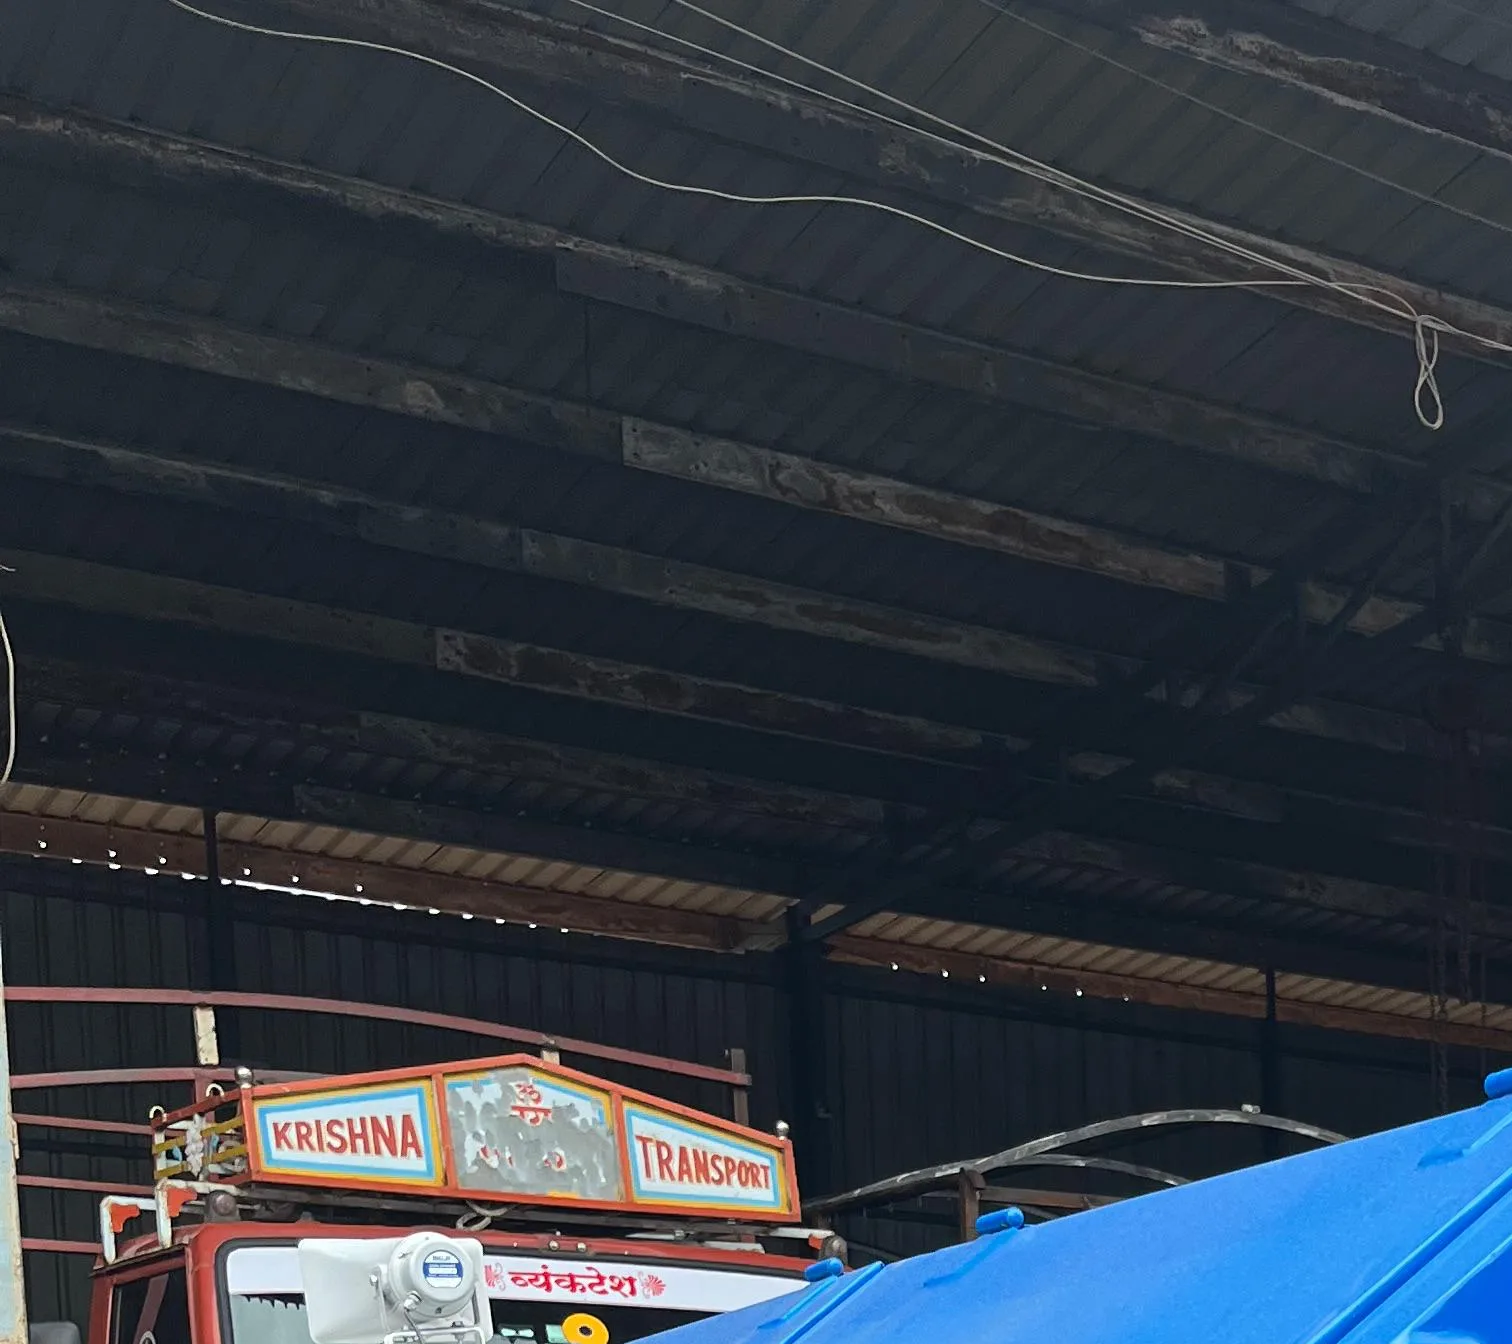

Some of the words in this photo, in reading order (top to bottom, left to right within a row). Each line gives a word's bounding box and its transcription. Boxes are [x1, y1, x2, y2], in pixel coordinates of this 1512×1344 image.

[272, 1113, 423, 1160] KRISHNA
[635, 1134, 771, 1191] TRANSPORT
[508, 1264, 637, 1298] व्यंकटेश
